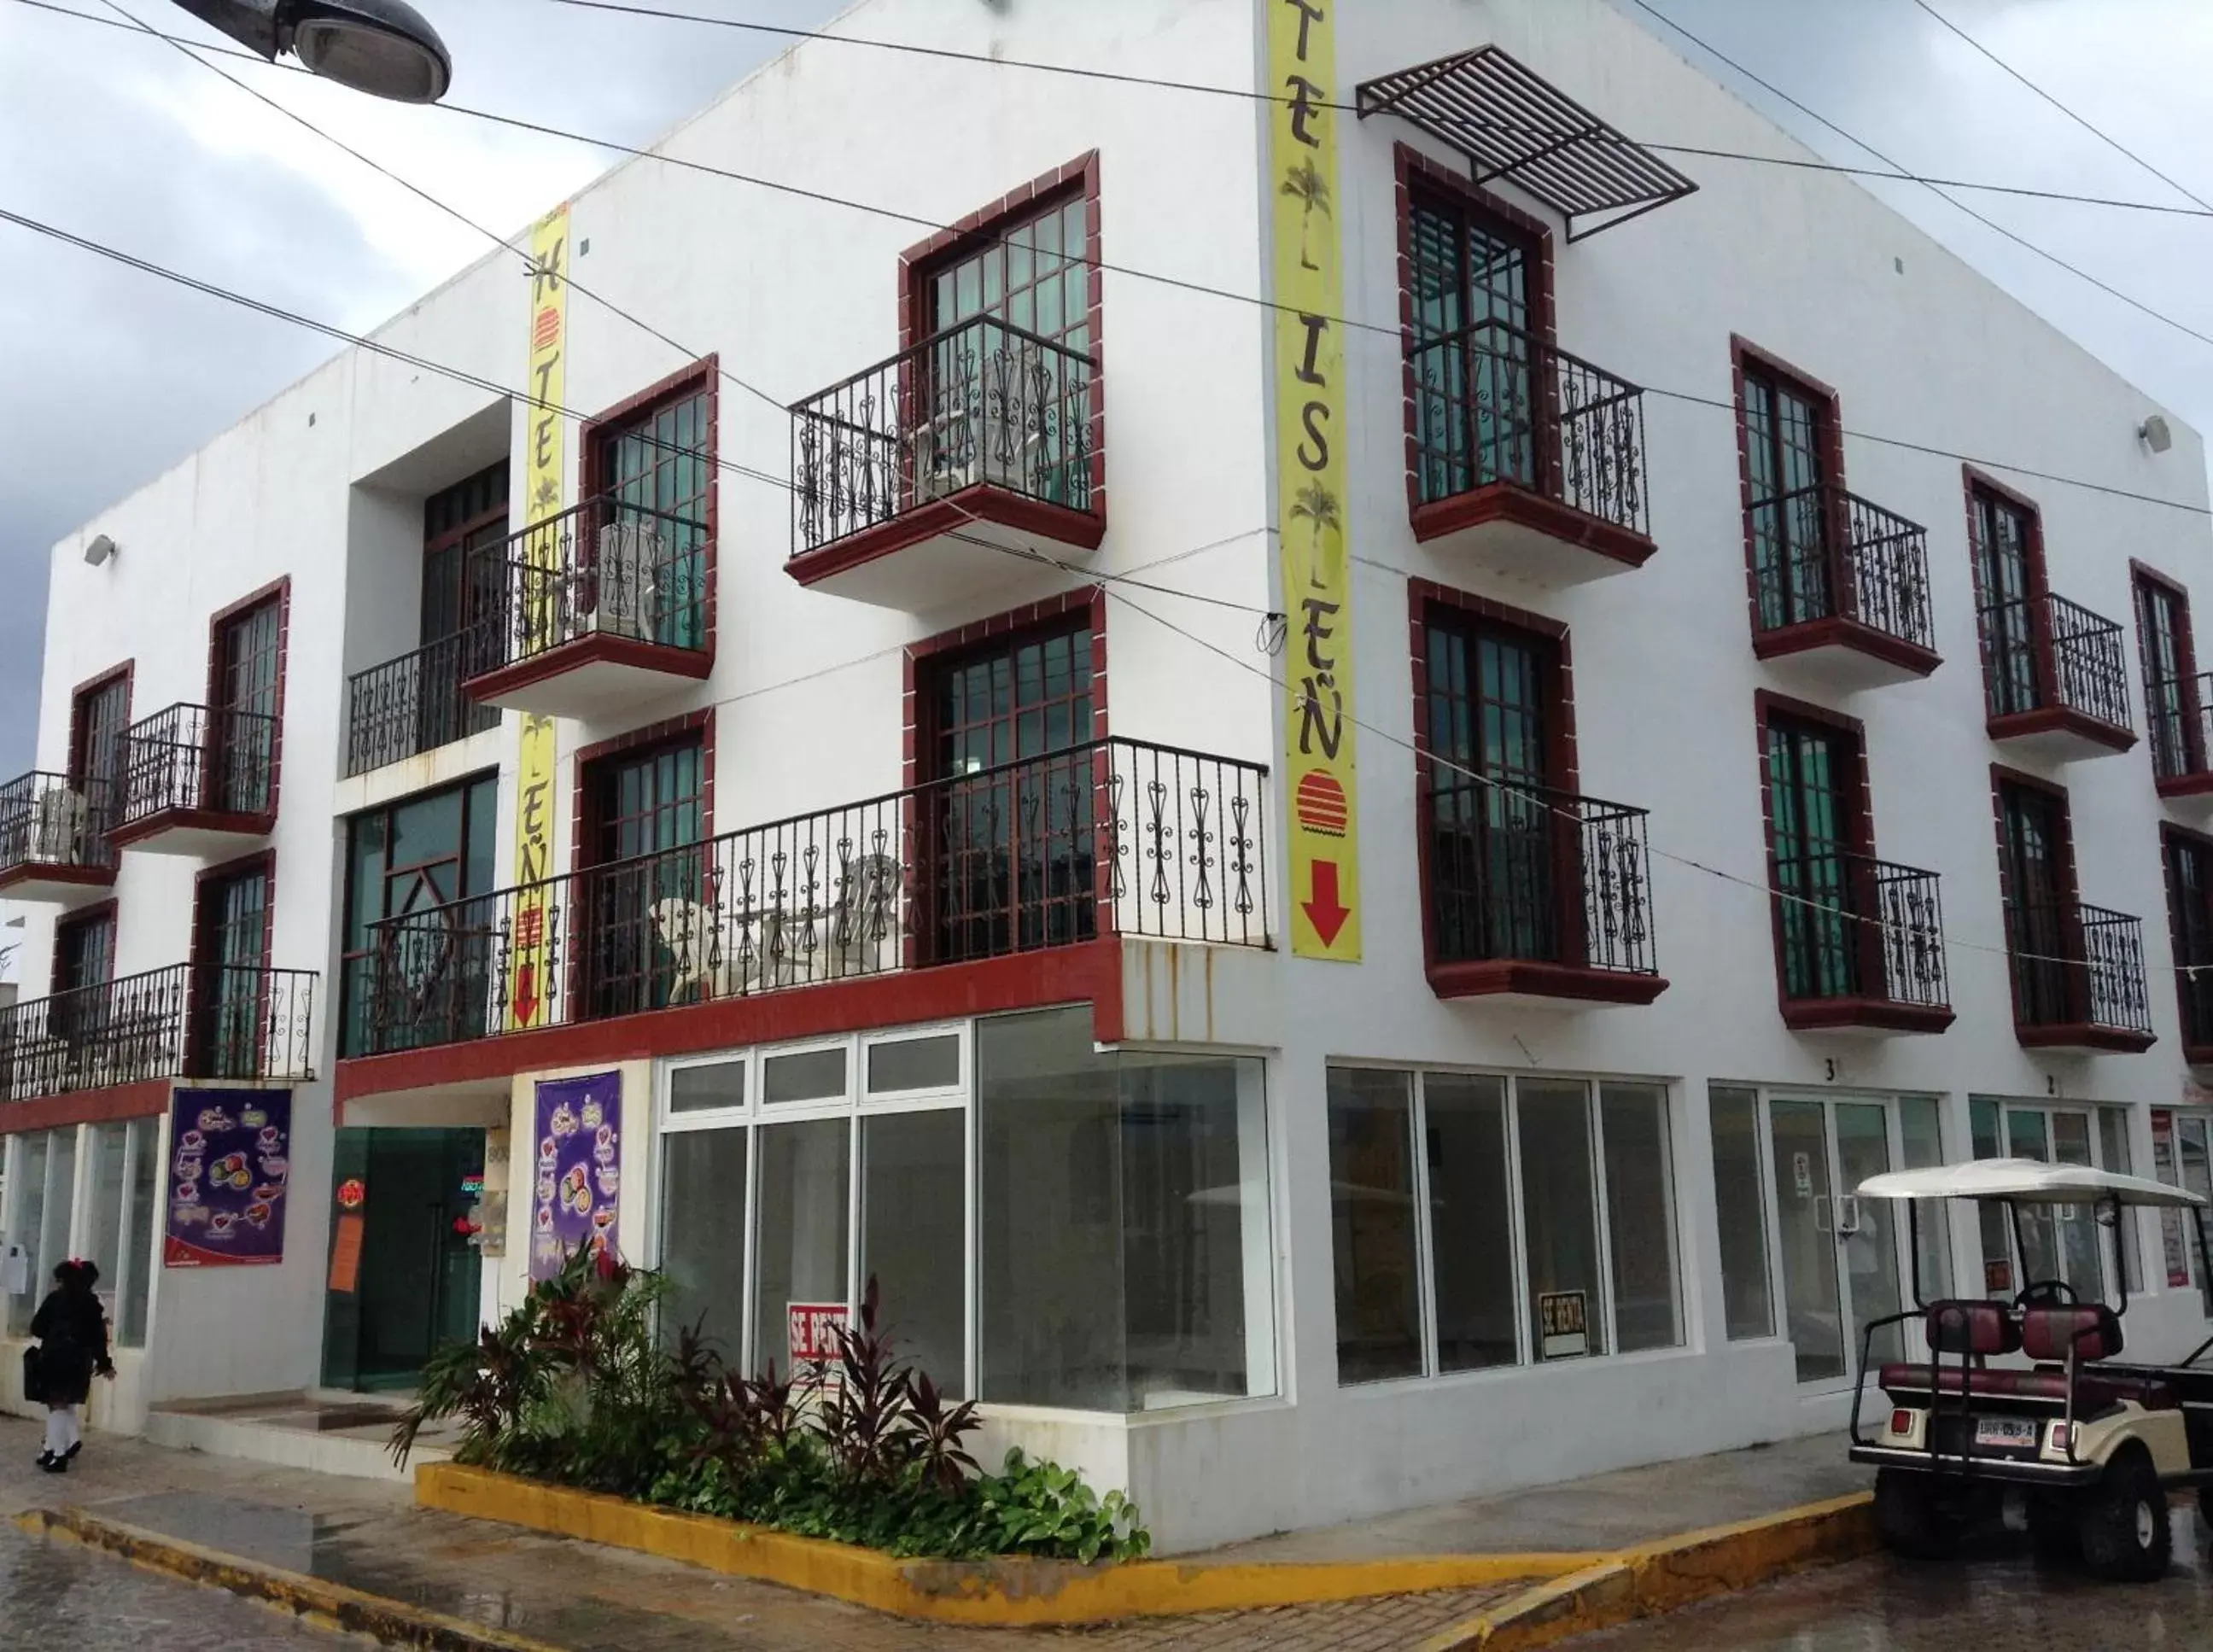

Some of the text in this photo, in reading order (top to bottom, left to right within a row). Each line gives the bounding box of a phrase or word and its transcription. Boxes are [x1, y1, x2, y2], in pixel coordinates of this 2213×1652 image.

[1825, 1057, 1836, 1082] 3
[2047, 1074, 2055, 1095] 2
[791, 1311, 847, 1355] SE RENT
